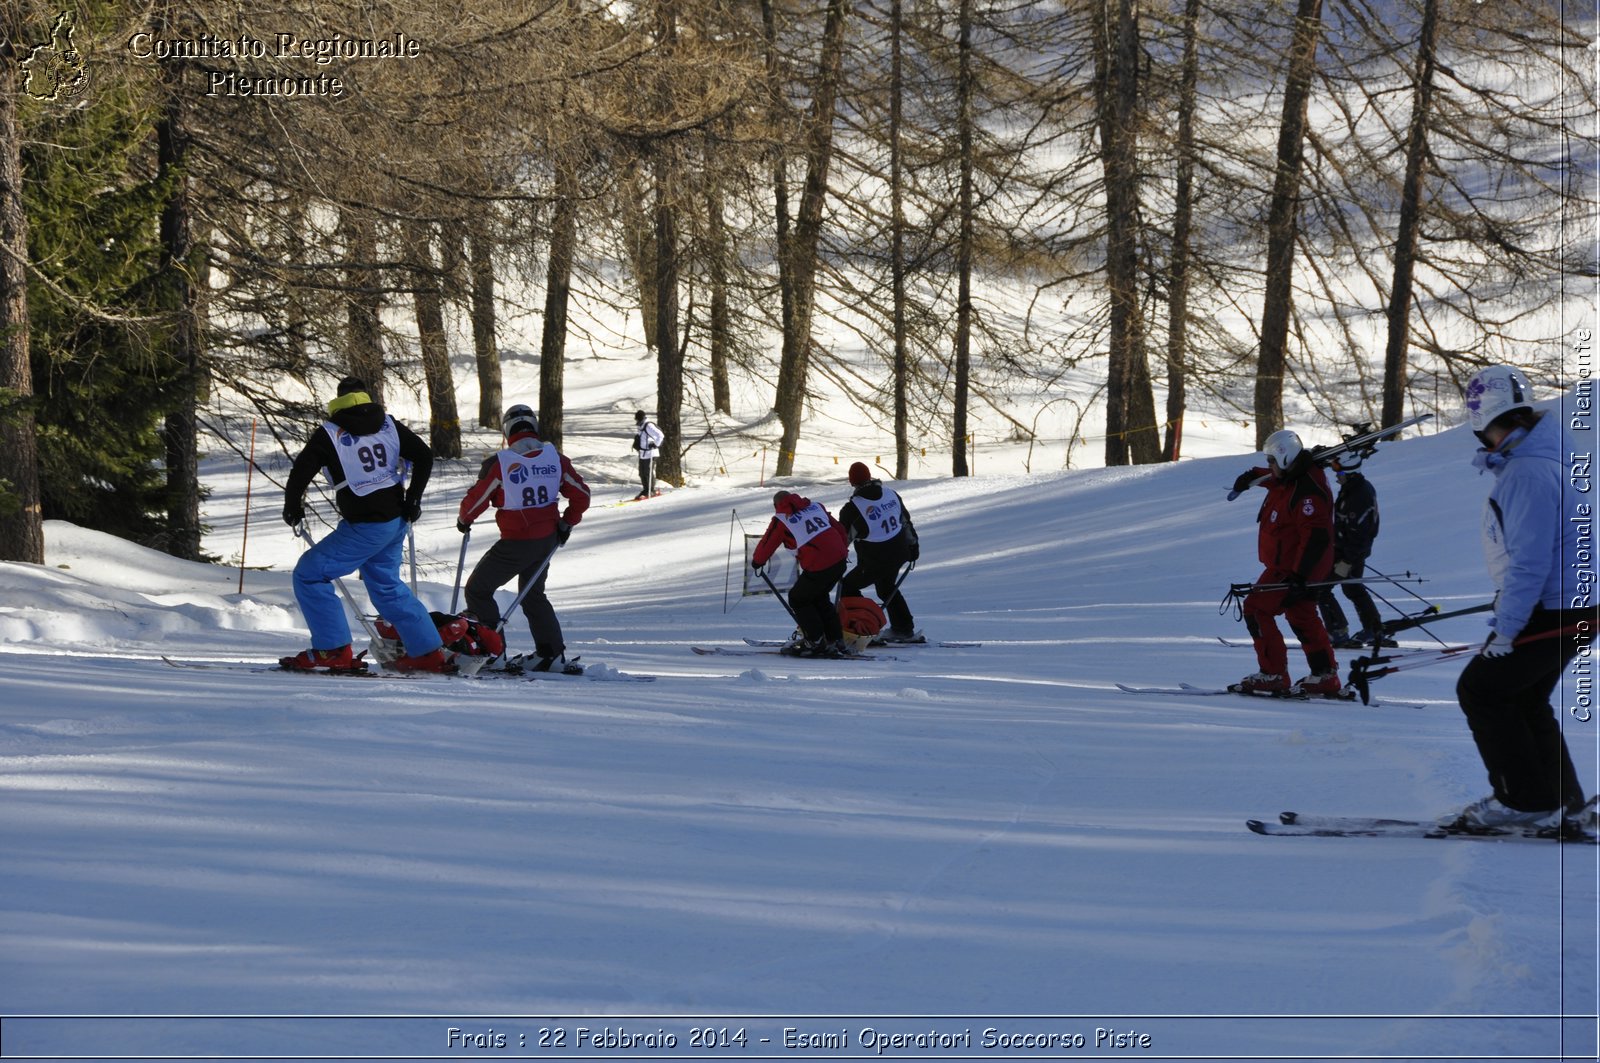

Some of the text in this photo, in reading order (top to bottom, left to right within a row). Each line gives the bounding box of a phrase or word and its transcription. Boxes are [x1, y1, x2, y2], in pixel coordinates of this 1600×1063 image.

[358, 443, 387, 473] 99
[531, 464, 557, 476] frais
[522, 485, 549, 507] 88
[804, 516, 828, 535] 48
[881, 515, 897, 534] 19
